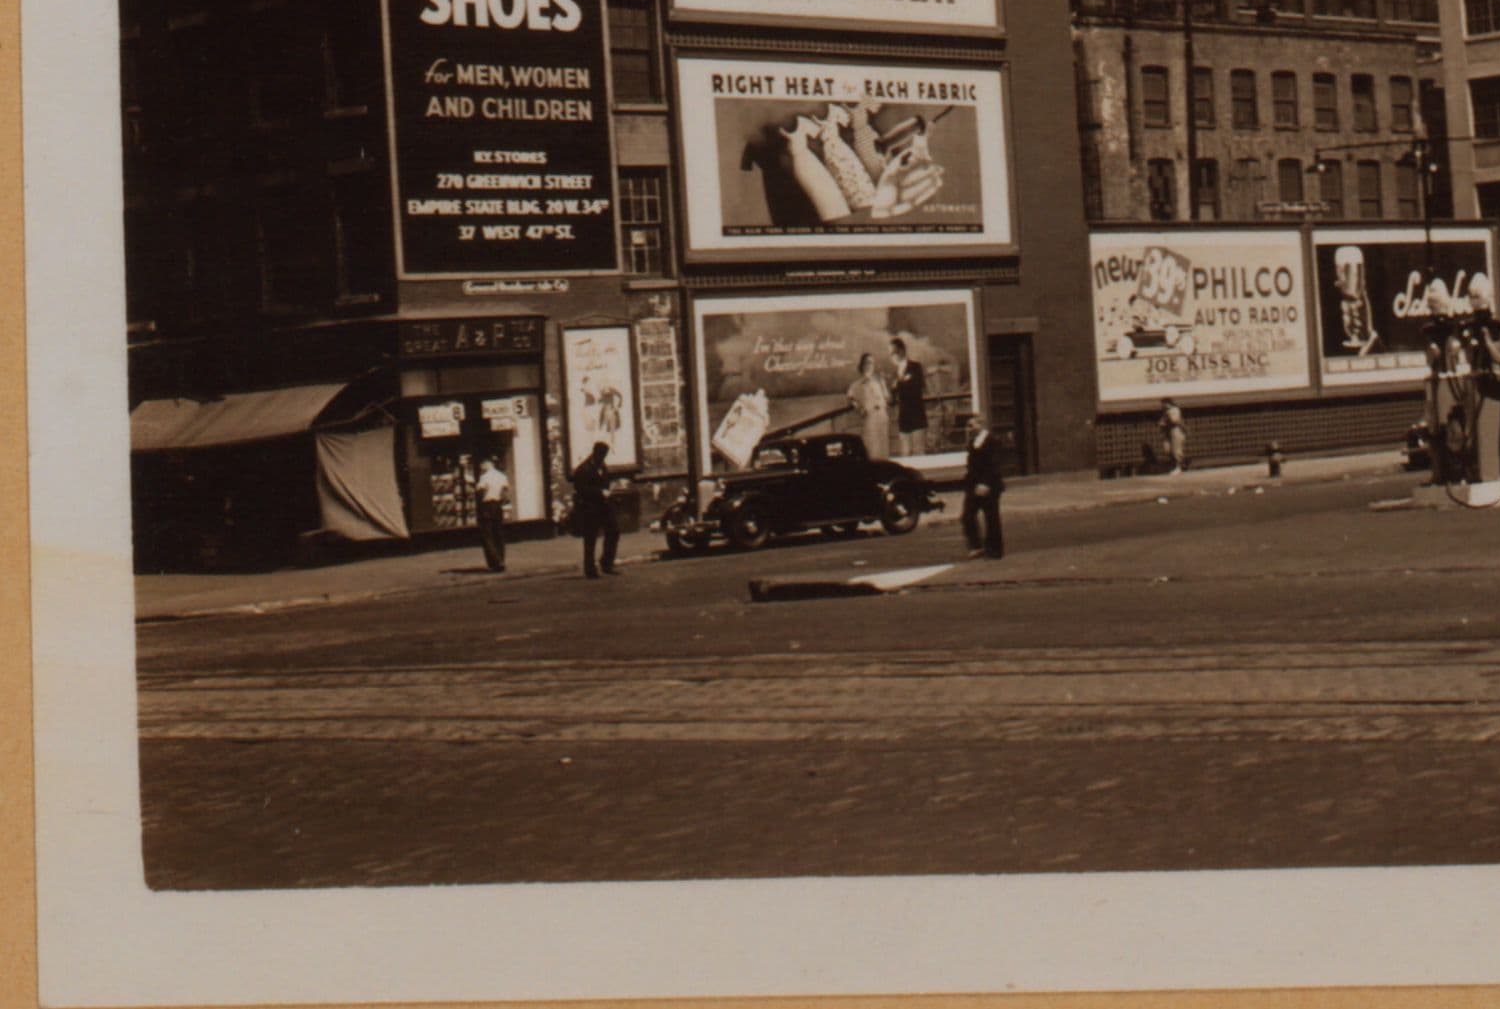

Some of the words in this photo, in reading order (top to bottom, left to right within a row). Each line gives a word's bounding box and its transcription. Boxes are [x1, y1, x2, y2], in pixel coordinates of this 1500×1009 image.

[425, 58, 453, 85] for
[456, 64, 509, 89] MEN,
[511, 66, 590, 89] WOMEN
[712, 73, 775, 95] RIGHT
[785, 76, 834, 98] HEAT
[864, 79, 908, 99] EACH
[917, 81, 977, 101] FABRIC
[425, 97, 475, 119] AND
[482, 98, 593, 122] CHILDREN
[494, 151, 548, 164] STORES
[437, 174, 464, 190] 270
[466, 174, 542, 190] GREENWICH
[544, 175, 593, 190] STREET
[407, 200, 462, 214] EMPIRE
[466, 200, 504, 214] STATE
[458, 225, 476, 240] 37
[482, 225, 521, 240] WEST
[1095, 254, 1144, 290] new
[1193, 267, 1293, 300] PHILCO
[1195, 307, 1241, 326] AUTO
[1250, 306, 1298, 324] RADIO
[454, 323, 468, 351] A
[1146, 358, 1178, 374] JOE
[1188, 354, 1232, 373] KISS
